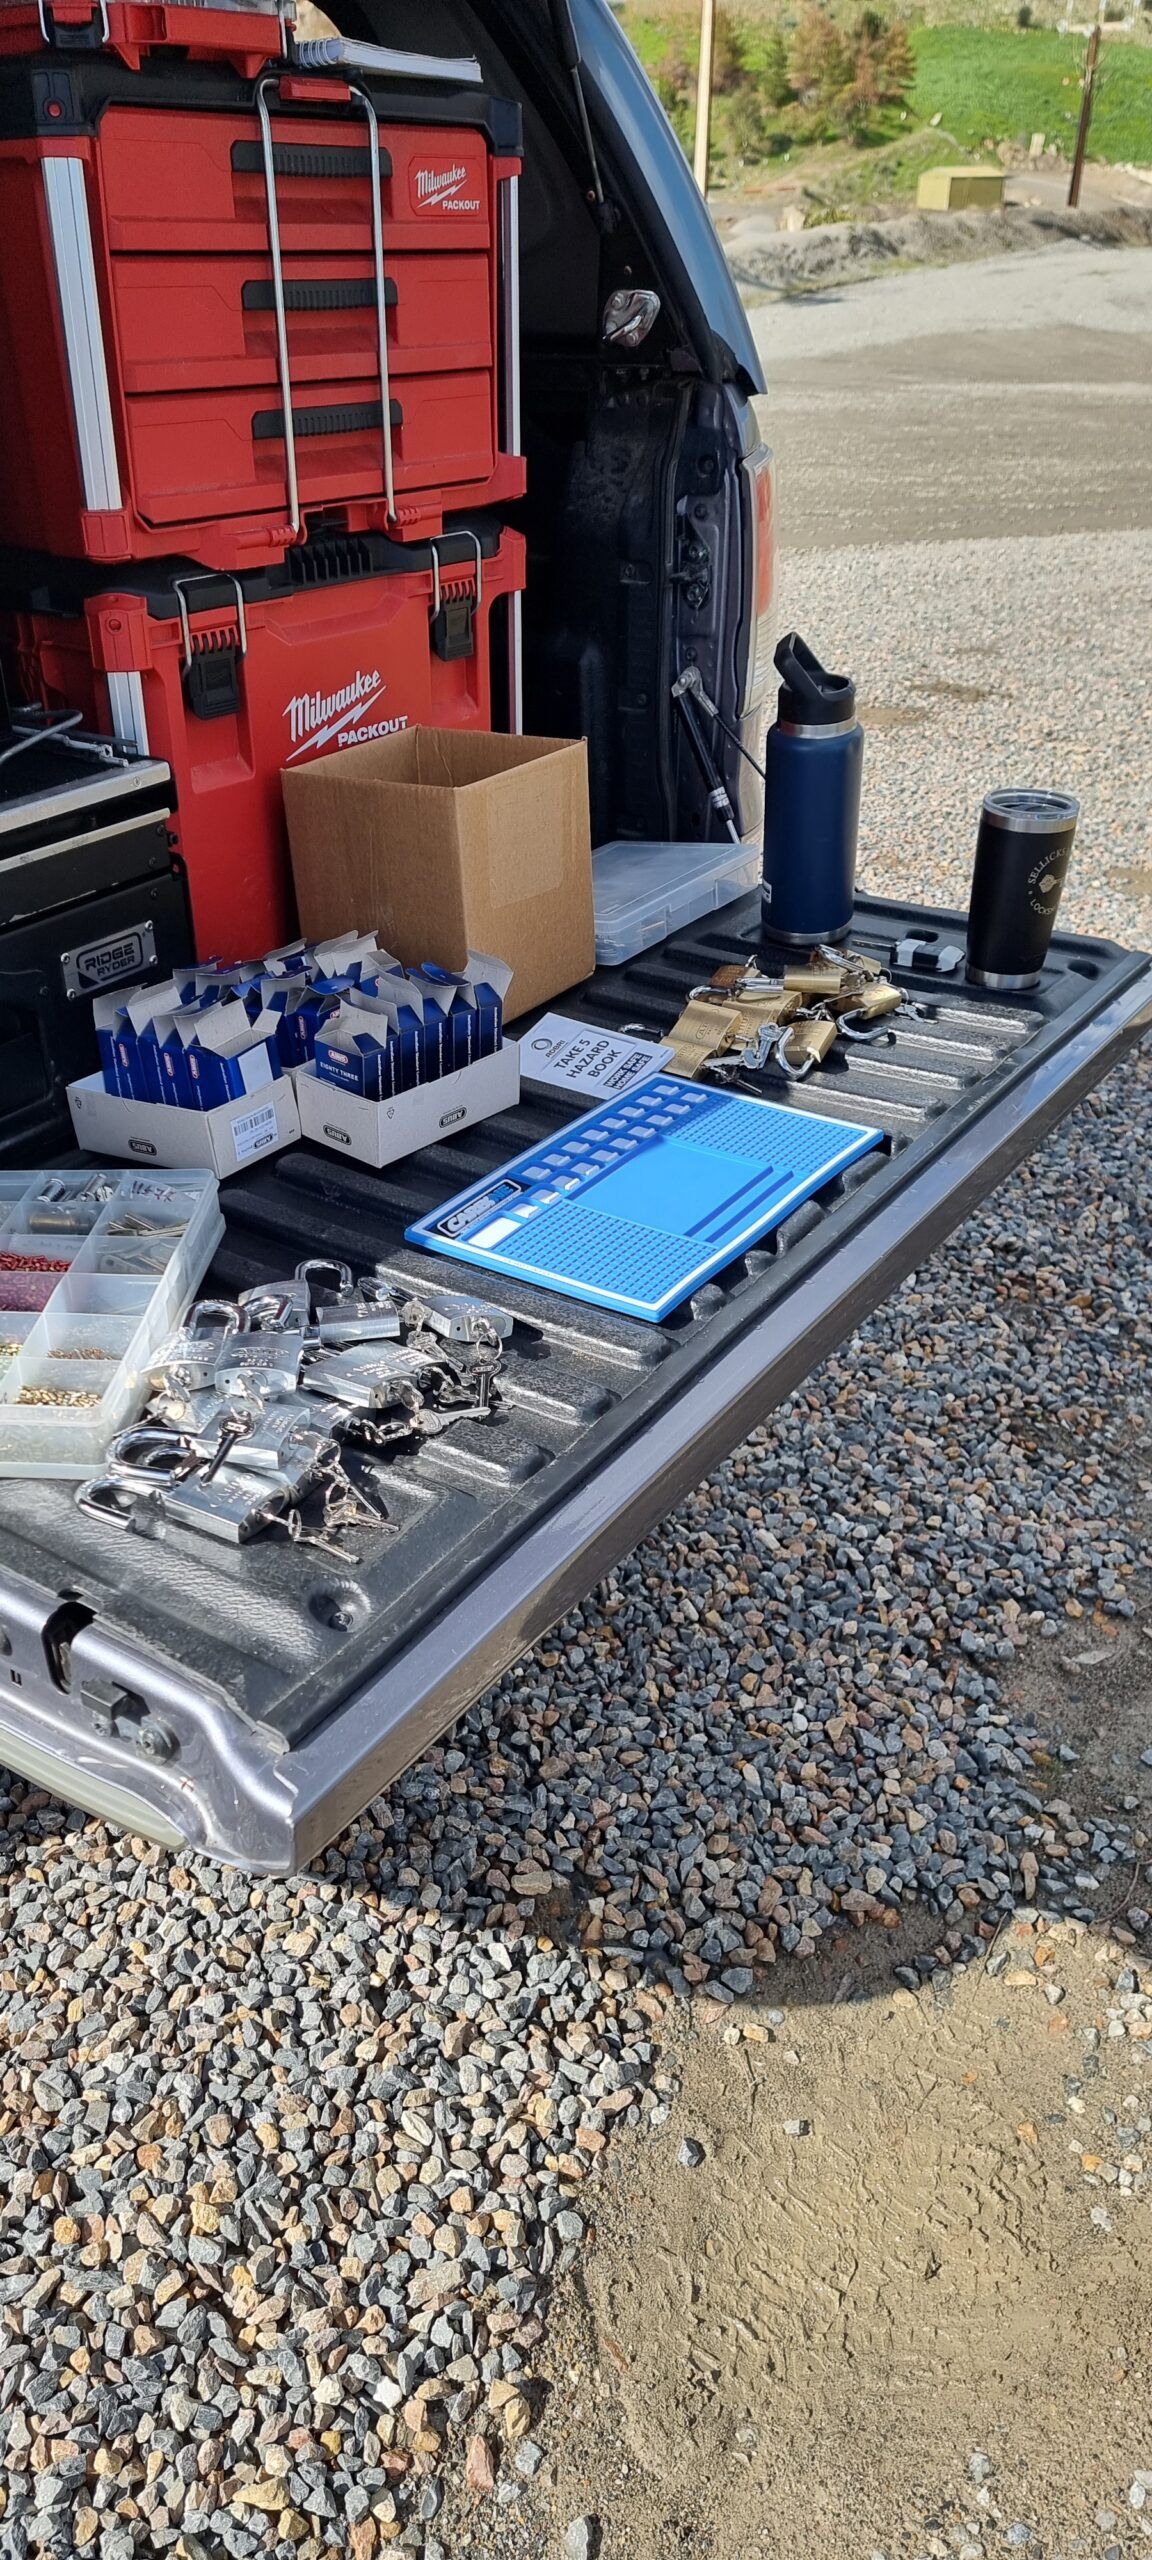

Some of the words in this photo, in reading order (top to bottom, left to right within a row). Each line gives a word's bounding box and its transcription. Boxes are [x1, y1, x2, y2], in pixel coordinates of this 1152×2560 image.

[414, 164, 467, 199] Milwaukee
[442, 200, 480, 210] PACKOUT
[282, 670, 381, 743] Milwaukee
[337, 716, 408, 747] PACKOUT
[84, 942, 135, 971] RIDGE
[96, 955, 136, 976] RYDER
[553, 1043, 585, 1069] TAKE
[580, 1038, 591, 1049] 5
[566, 1040, 610, 1078] HAZARD
[587, 1049, 622, 1078] BOOK
[320, 1062, 340, 1076] EIGHTY
[340, 1068, 359, 1081] THREE
[605, 1065, 627, 1087] WORK
[622, 1053, 642, 1070] SAFE
[614, 1070, 635, 1090] HOME
[632, 1056, 651, 1072] SAFE
[441, 1108, 465, 1127] ABUS
[131, 1141, 155, 1154] ABUS
[326, 1127, 349, 1143] ABUS
